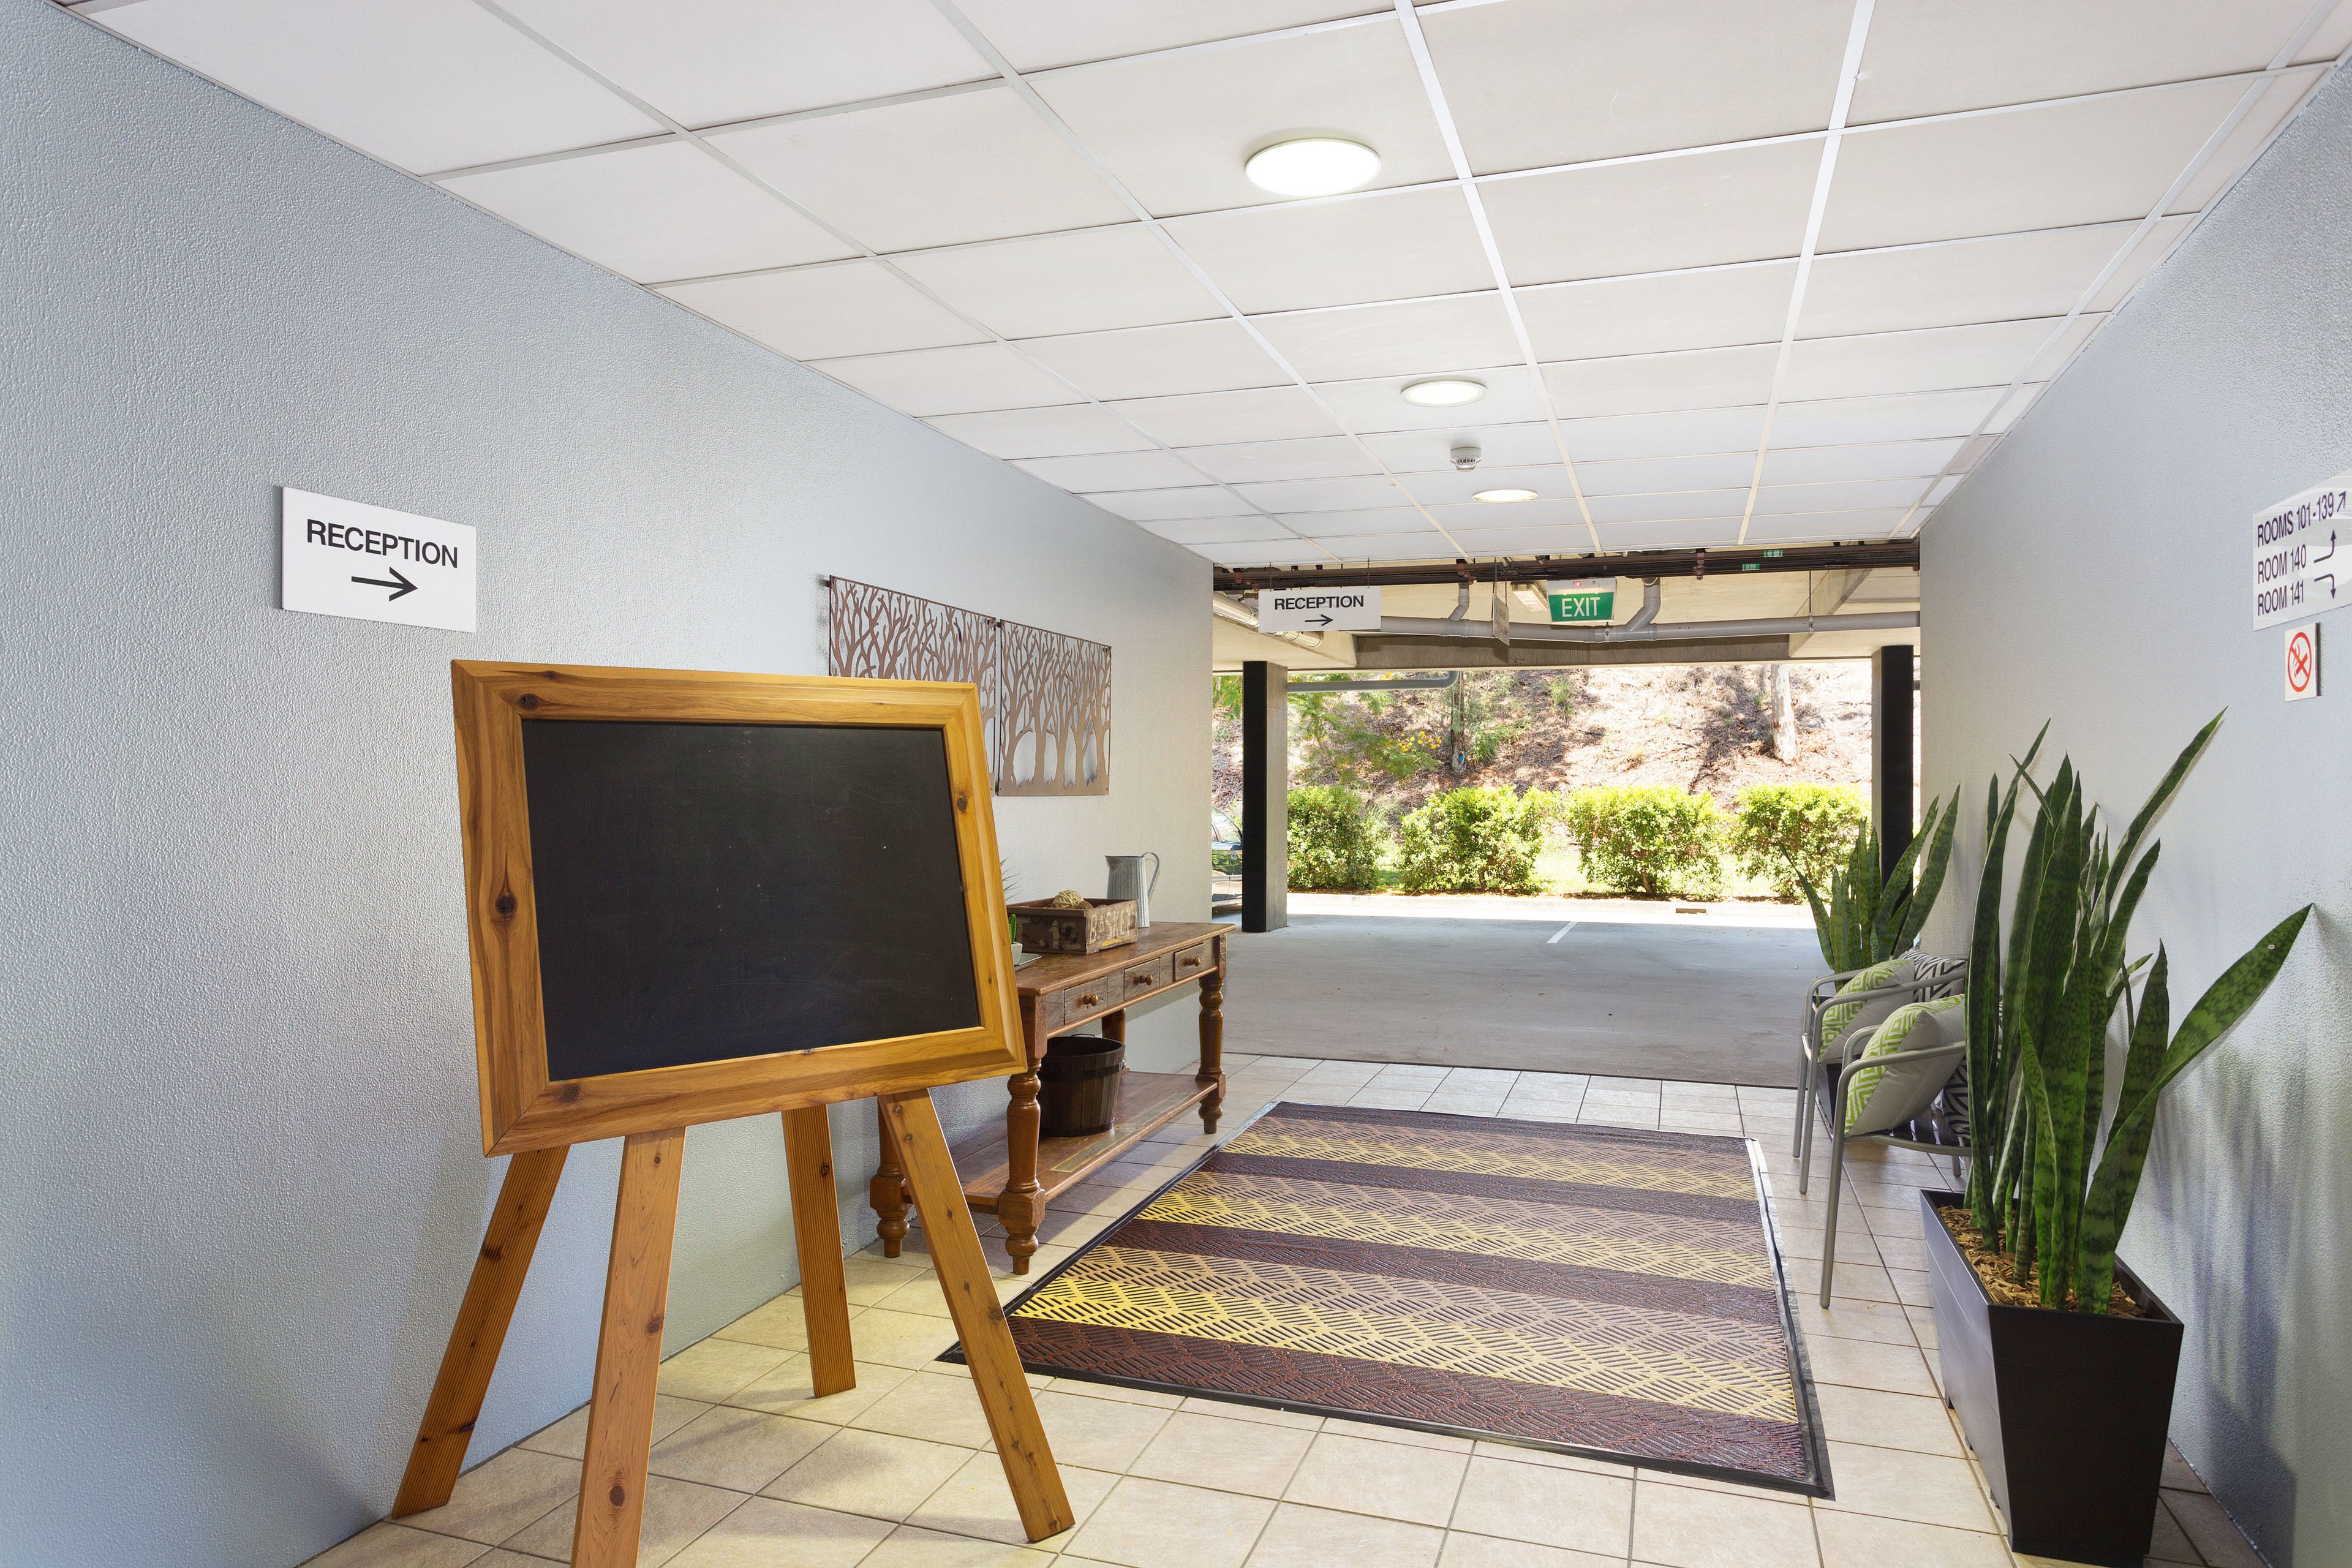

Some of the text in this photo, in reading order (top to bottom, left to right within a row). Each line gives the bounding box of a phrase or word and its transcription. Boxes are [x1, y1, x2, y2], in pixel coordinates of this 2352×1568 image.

[307, 518, 458, 568] RECEPTION
[2257, 510, 2294, 548] ROOMS
[2258, 544, 2307, 585] ROOM 140
[1274, 595, 1365, 611] RECEPTION
[1561, 597, 1600, 618] EXIT
[2258, 579, 2304, 617] ROOM 141
[1090, 907, 1134, 943] BASKET
